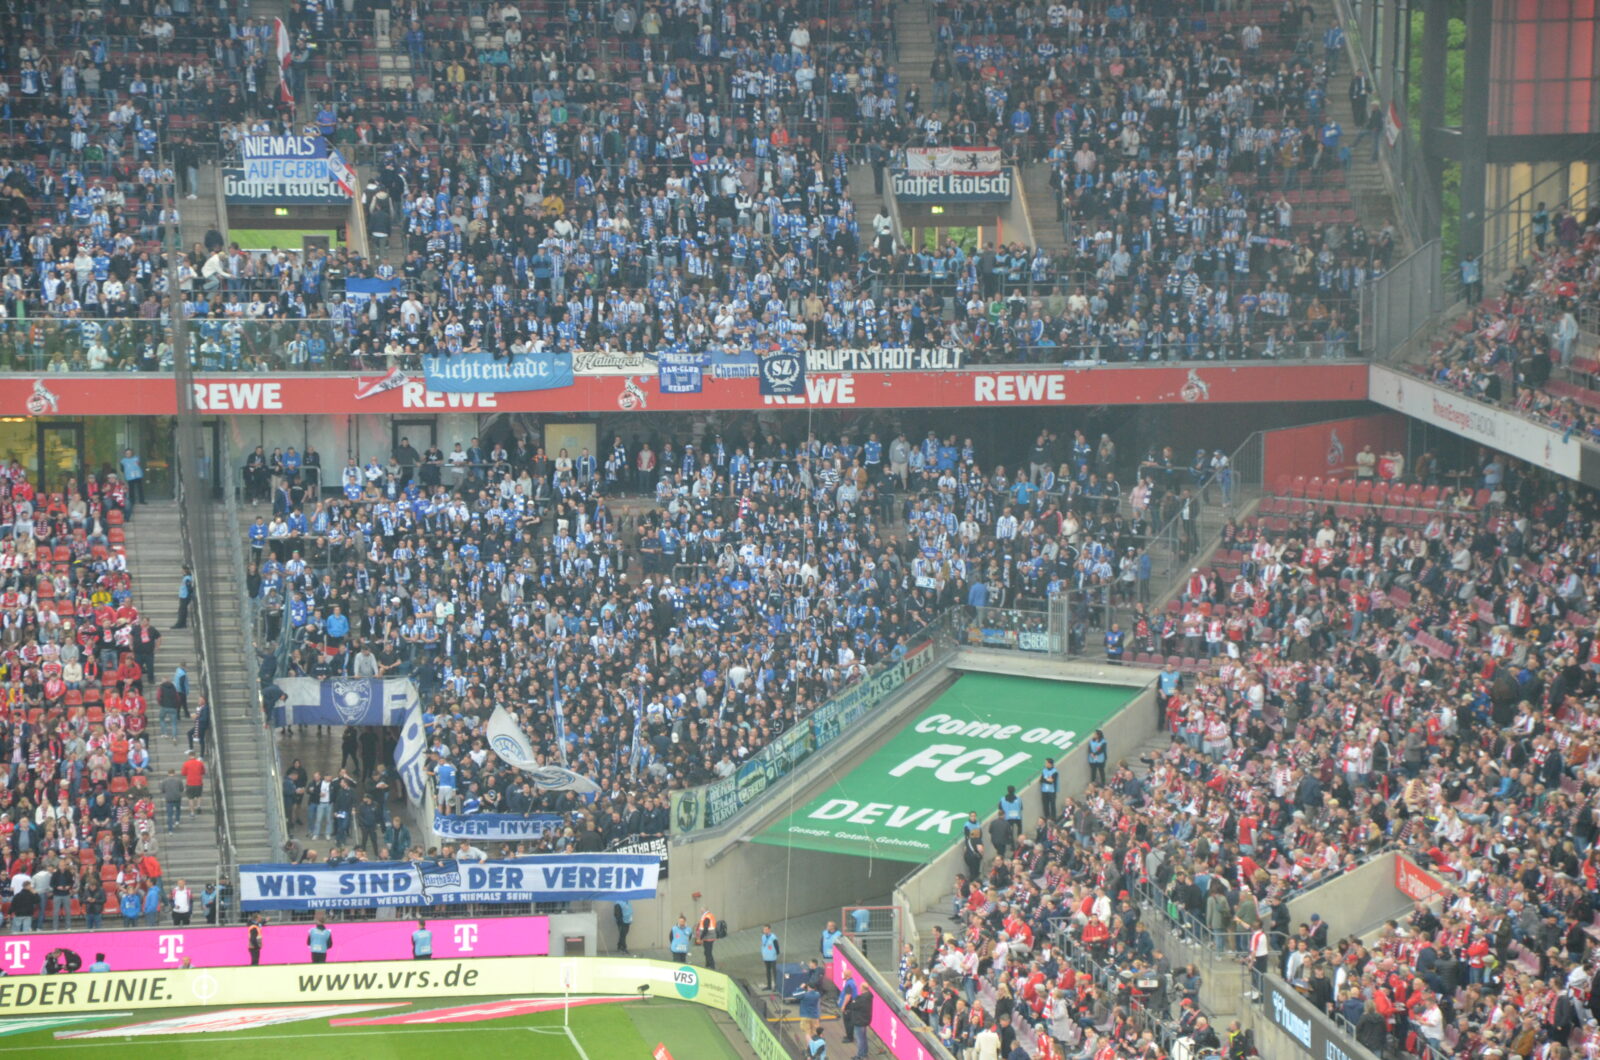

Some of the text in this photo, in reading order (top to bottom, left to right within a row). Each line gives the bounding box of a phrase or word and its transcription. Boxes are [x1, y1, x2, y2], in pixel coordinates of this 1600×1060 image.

[244, 136, 315, 157] NIEMALS
[249, 159, 328, 179] AUFGEBEN
[772, 359, 792, 376] SZ
[806, 348, 963, 370] HAUPTSTADT-KULT
[187, 382, 282, 410] REWE
[402, 381, 497, 408] REWE
[974, 374, 1066, 401] REWE
[914, 713, 1076, 750] Come on,
[888, 743, 1032, 786] FC!
[808, 798, 971, 835] DEVK
[256, 866, 645, 897] WIR SIND DER VEREIN
[307, 892, 533, 908] INVESTOREN WERDEN ES NIEMALS SEIN!
[87, 977, 173, 1004] LINIE.
[298, 963, 479, 992] www.vrs.de
[673, 971, 694, 984] VRS
